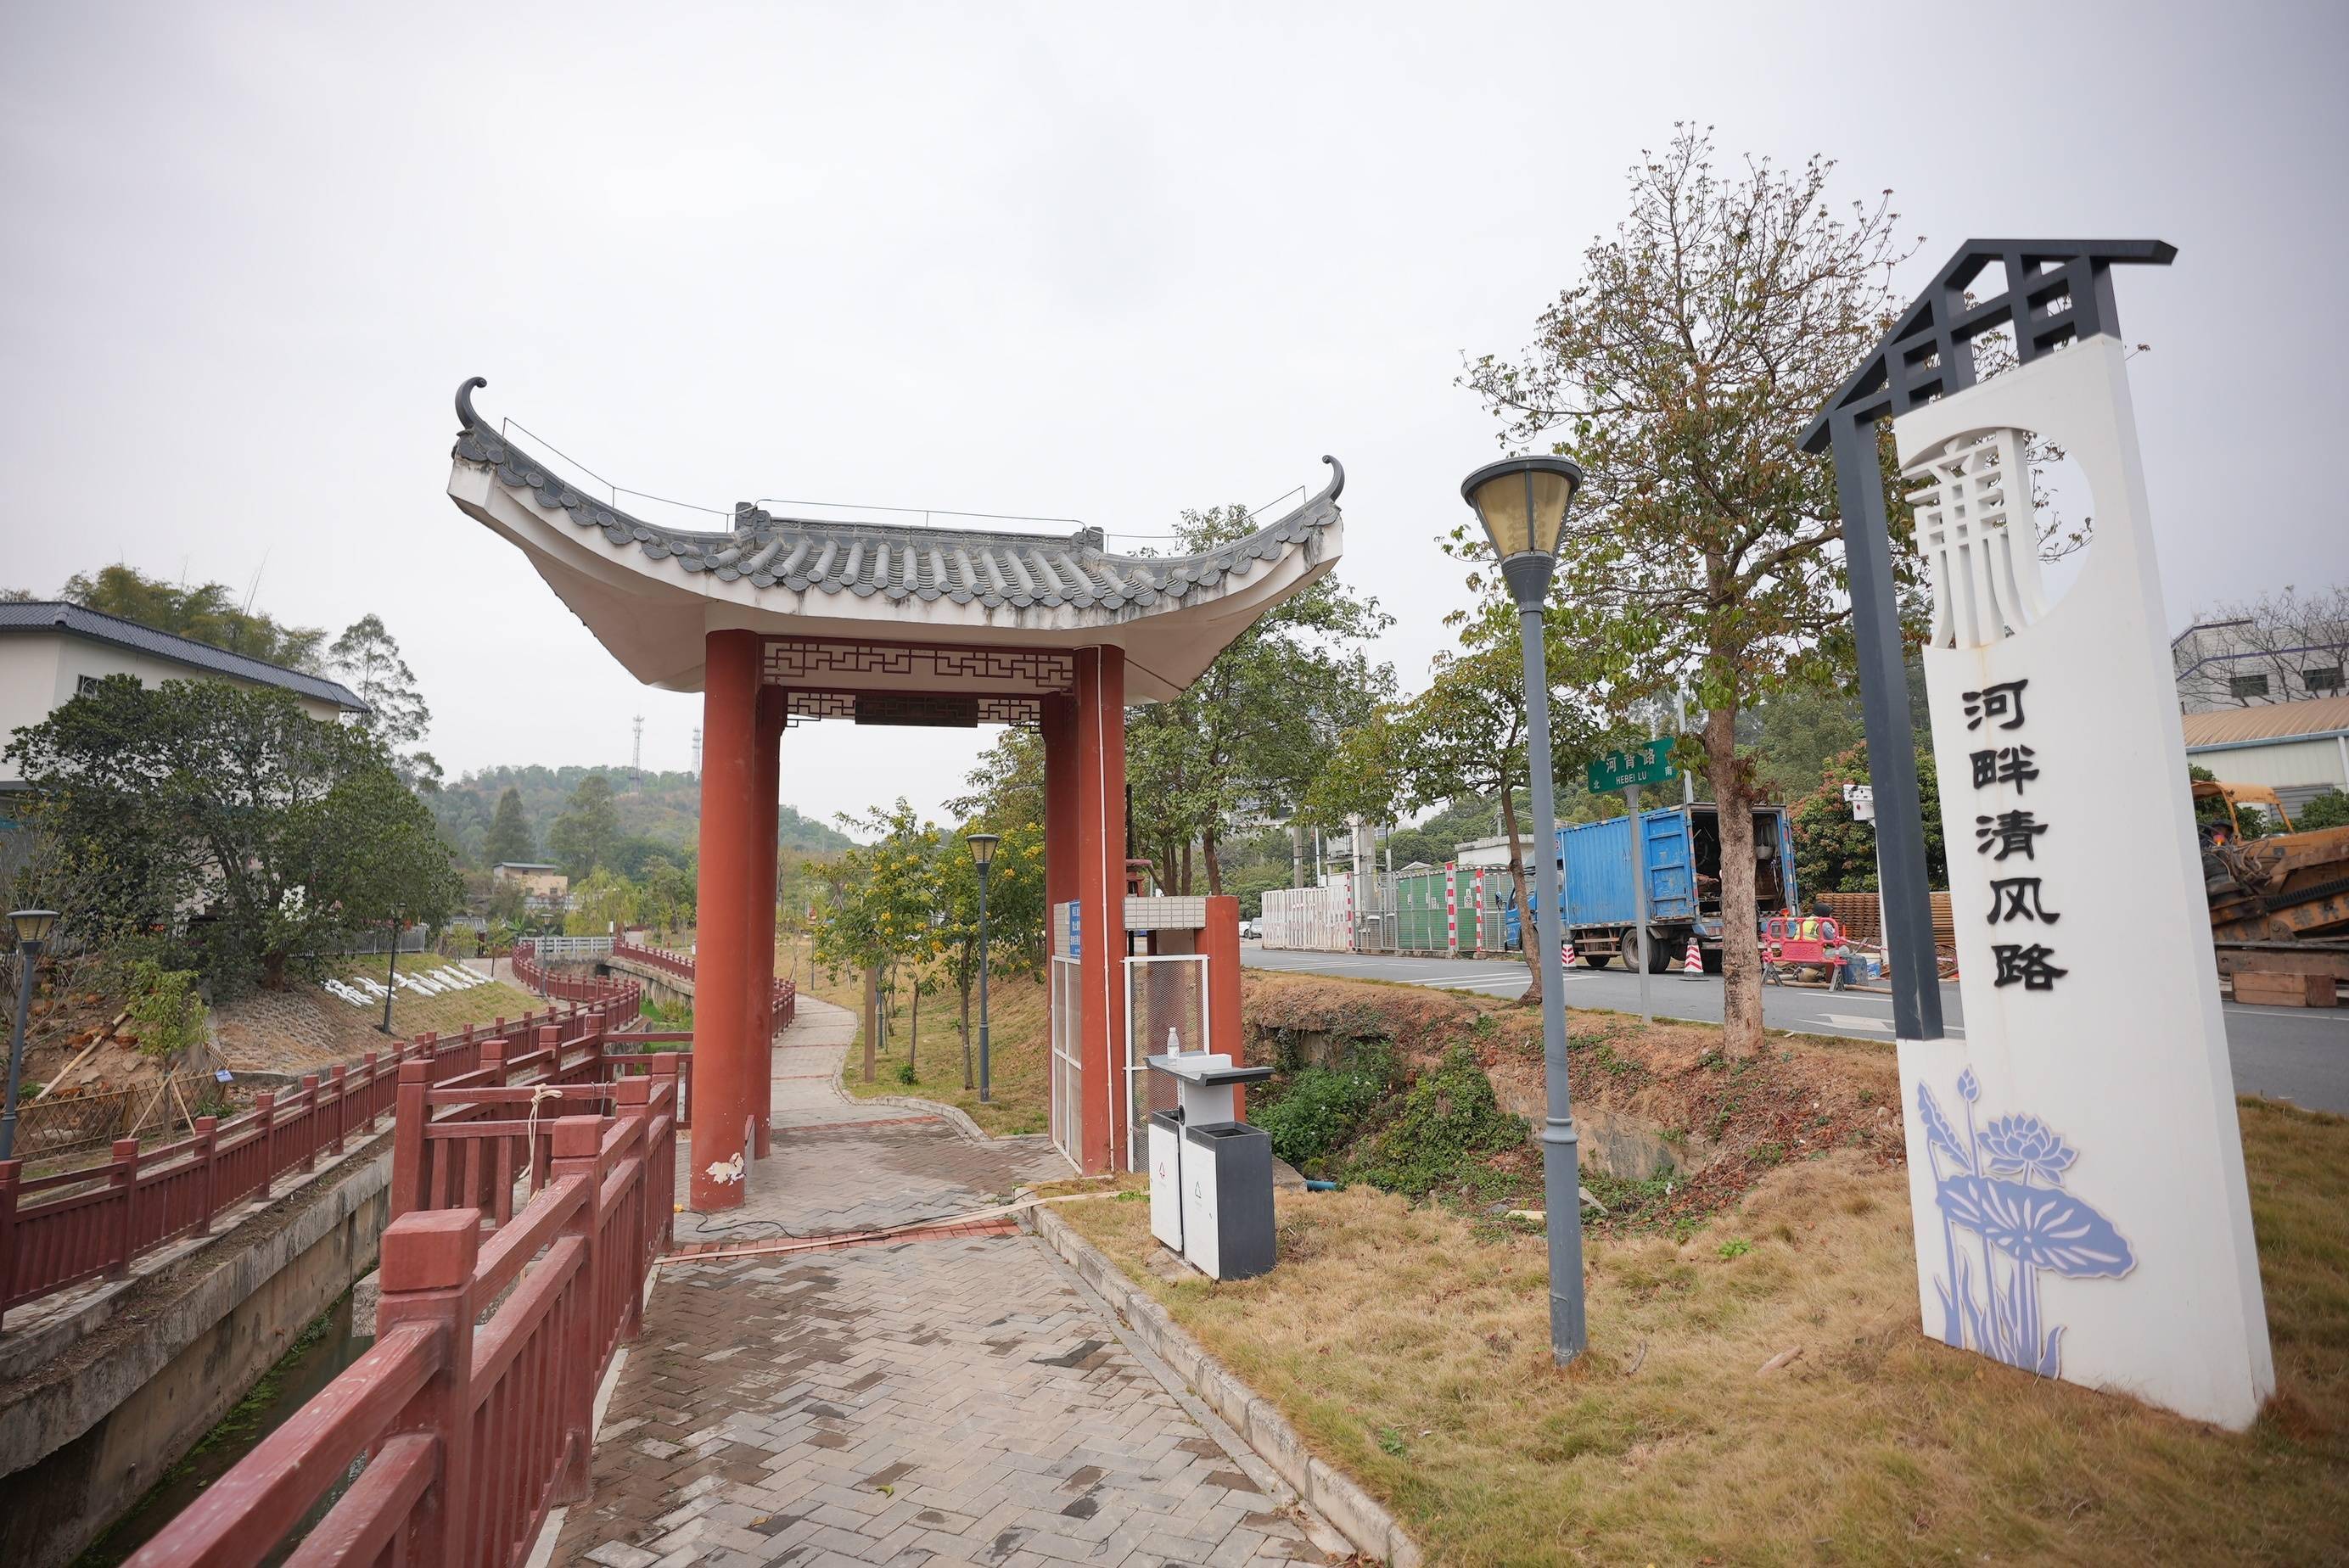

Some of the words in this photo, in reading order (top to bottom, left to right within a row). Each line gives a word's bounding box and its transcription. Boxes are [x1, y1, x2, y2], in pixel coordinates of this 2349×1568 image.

[1606, 748, 1655, 773] 河背路
[1665, 765, 1673, 776] 南
[1593, 780, 1601, 790] 北
[1616, 774, 1635, 785] HEBEI
[1638, 771, 1647, 781] LU
[1962, 678, 2068, 990] 河畔清风路
